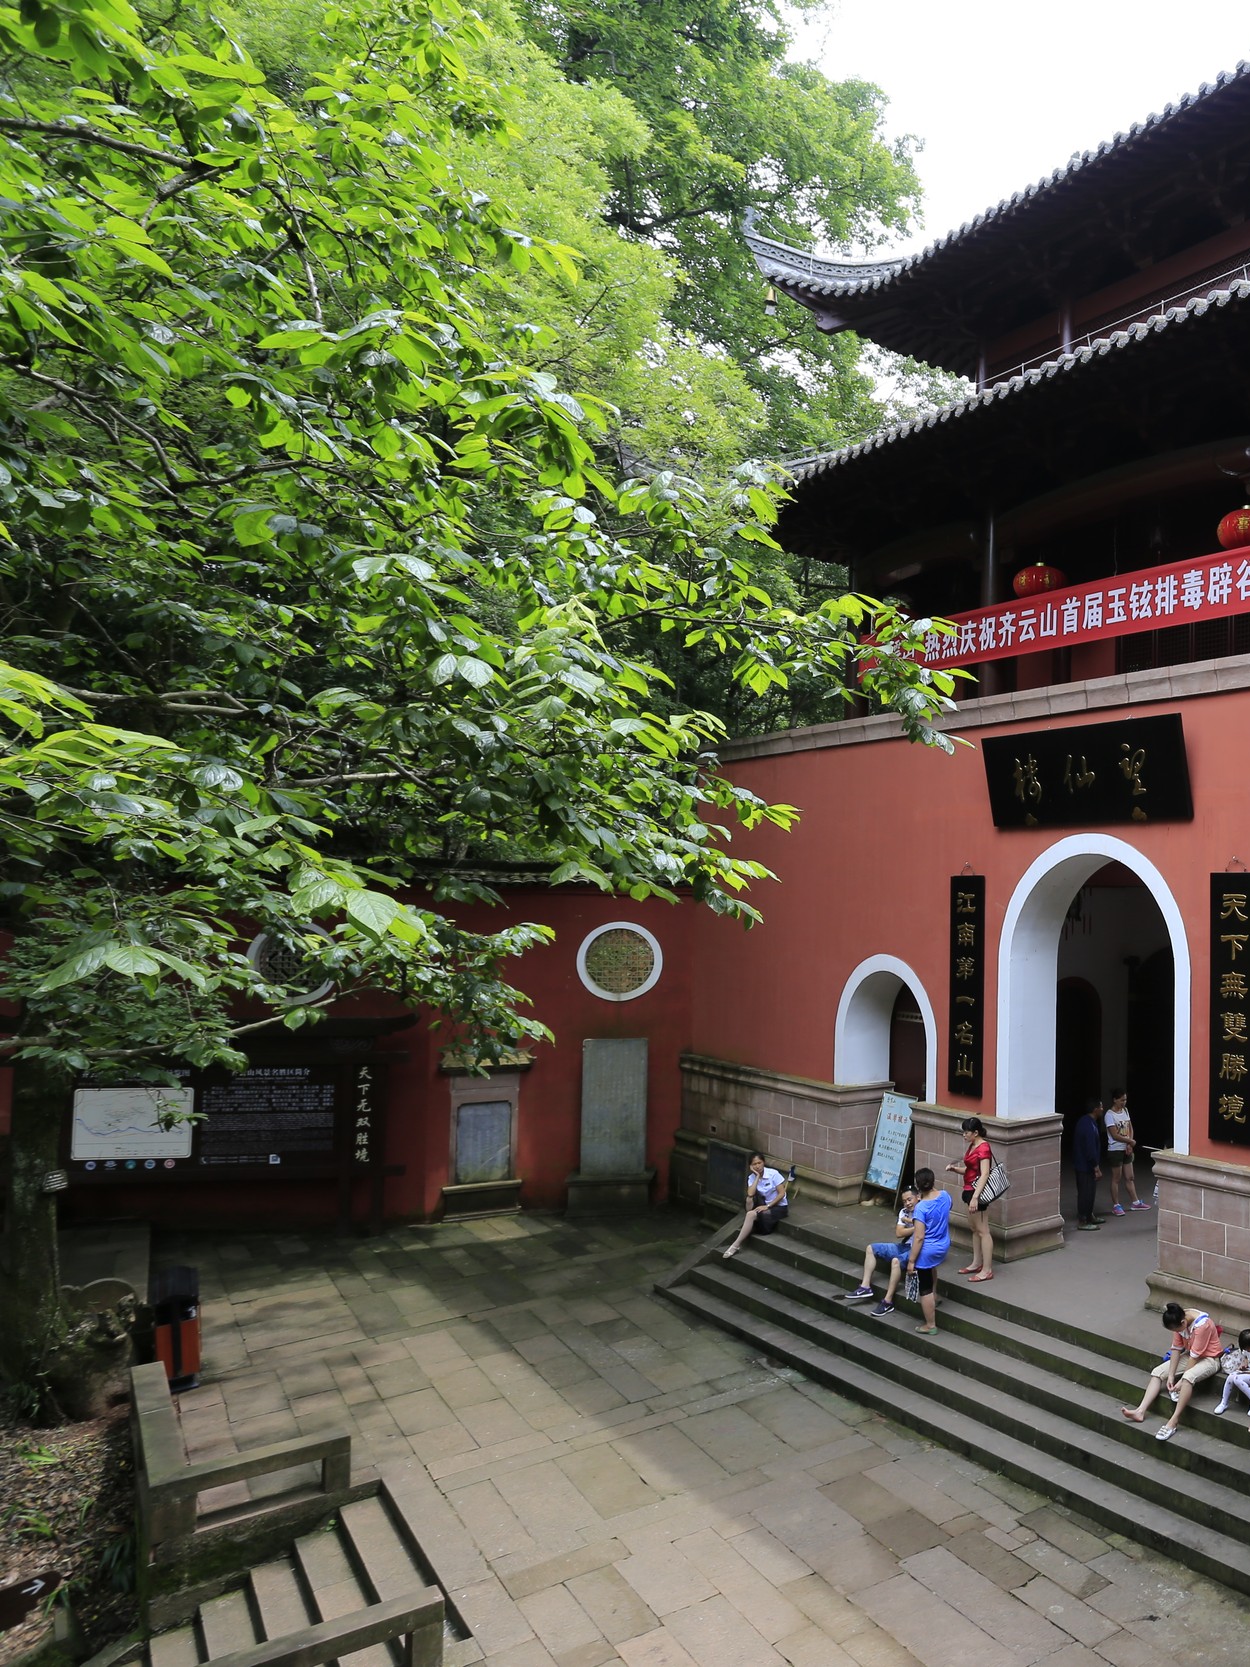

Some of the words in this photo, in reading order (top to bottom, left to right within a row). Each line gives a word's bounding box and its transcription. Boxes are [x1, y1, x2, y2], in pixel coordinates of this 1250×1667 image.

[955, 891, 976, 1078] 江南第一名山
[355, 1066, 372, 1162] 天下无双胜境
